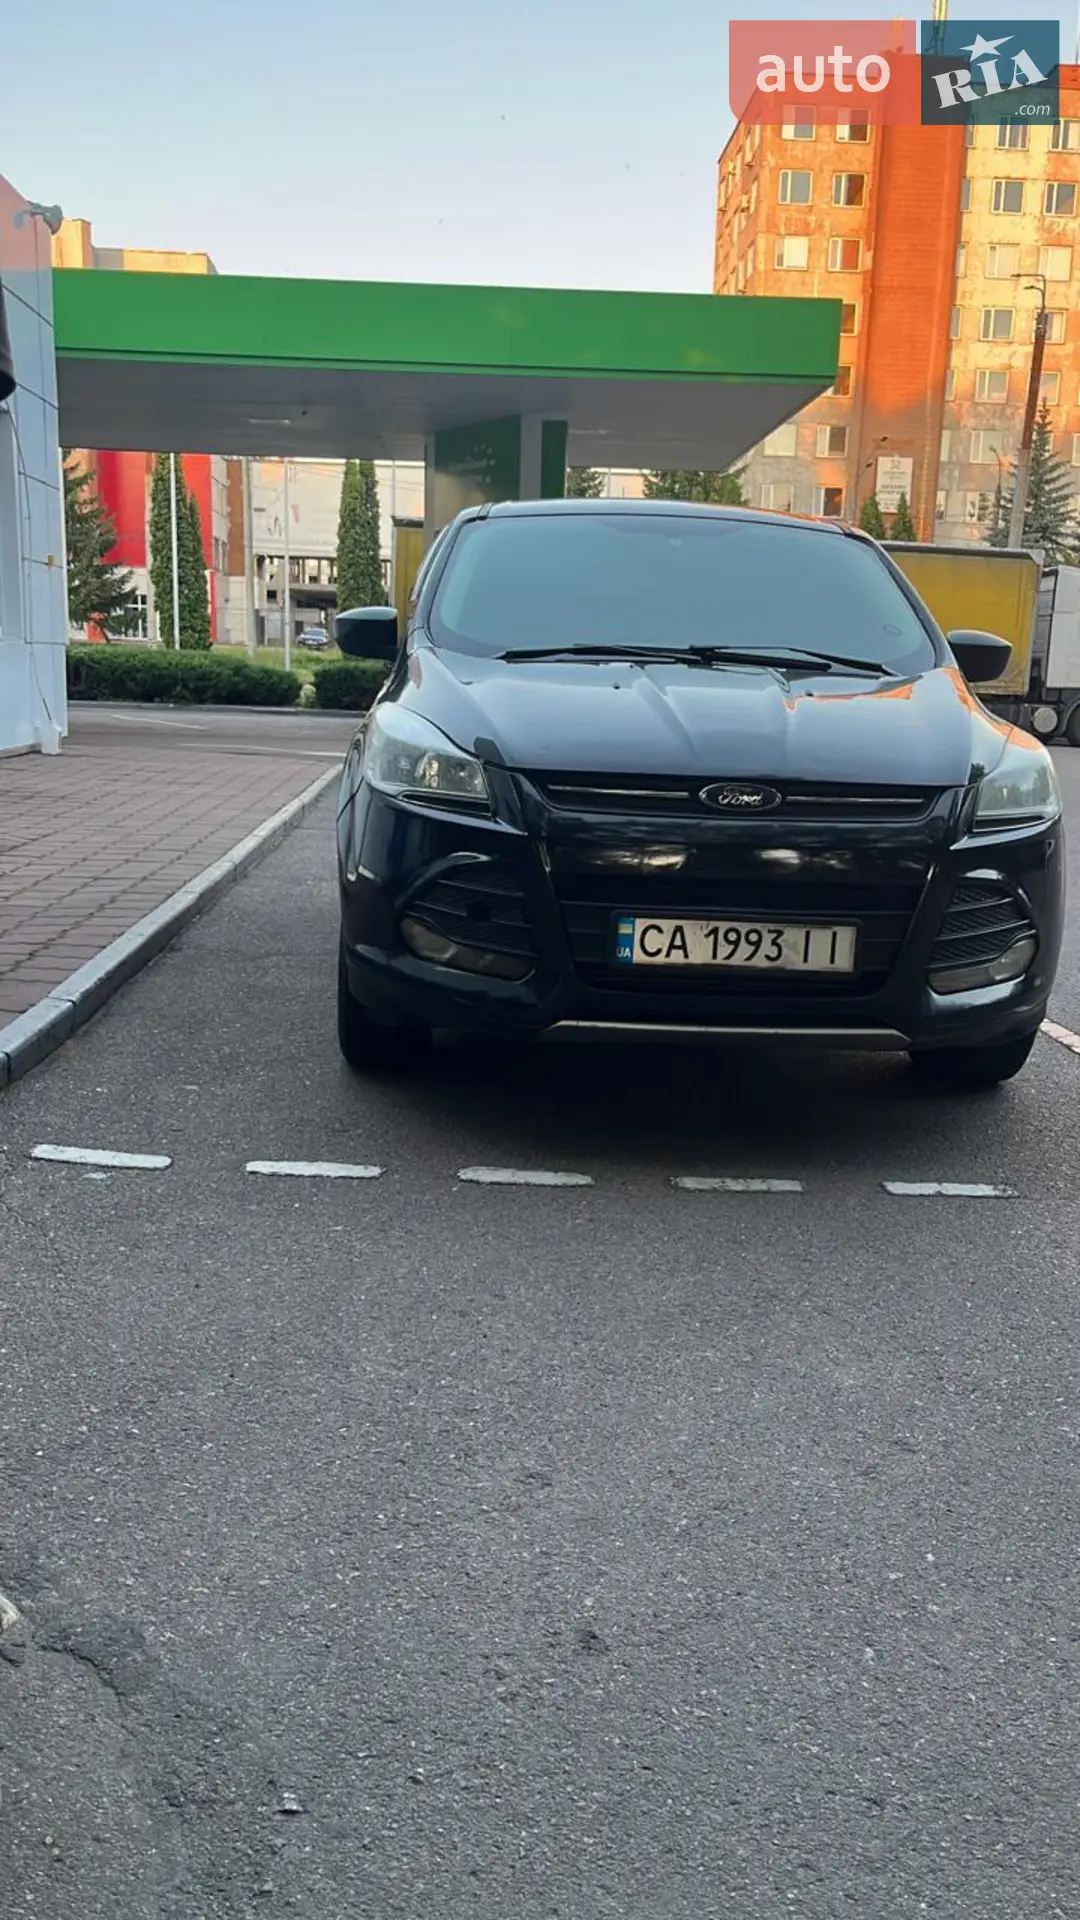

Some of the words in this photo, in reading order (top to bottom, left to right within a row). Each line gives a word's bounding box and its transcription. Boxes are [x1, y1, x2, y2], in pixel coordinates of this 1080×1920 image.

[718, 786, 763, 805] Ford
[639, 924, 689, 959] CA
[704, 926, 783, 962] 1993
[616, 948, 632, 958] UA
